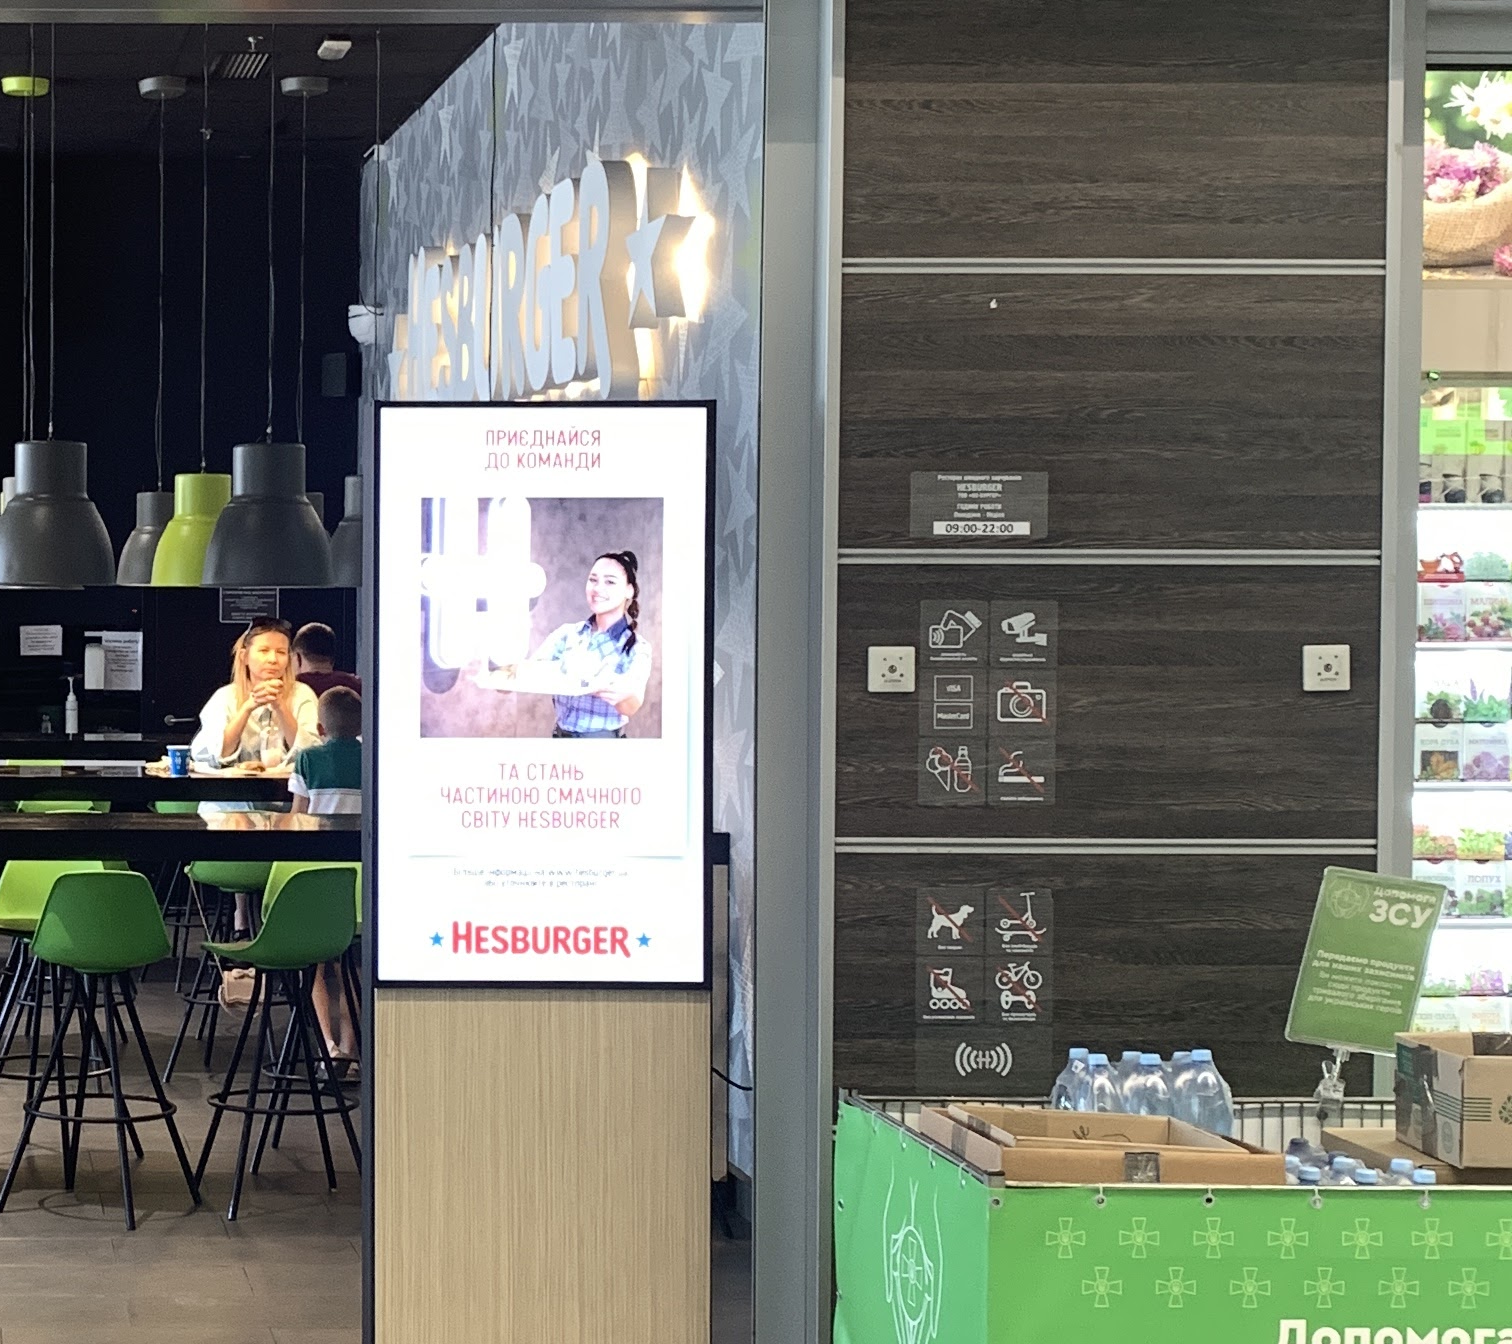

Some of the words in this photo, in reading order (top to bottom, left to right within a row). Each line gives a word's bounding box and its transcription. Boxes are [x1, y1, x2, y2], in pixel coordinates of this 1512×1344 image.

[406, 160, 614, 401] HESBURGER
[485, 425, 601, 449] ПРИЄДНАЙСЯ
[485, 453, 510, 472] ДО
[516, 453, 601, 472] КОМАНДИ
[945, 523, 1014, 534] 09:00-22:00
[498, 763, 520, 781] ТА
[527, 763, 584, 781] СТАНЬ
[441, 786, 539, 805] ЧАСТИНОЮ
[547, 786, 641, 805] СМАЧНОГО
[461, 810, 510, 829] СВІТУ
[518, 810, 620, 829] HESBURGER
[1368, 899, 1434, 929] ЗСУ
[452, 920, 631, 958] HESBURGER
